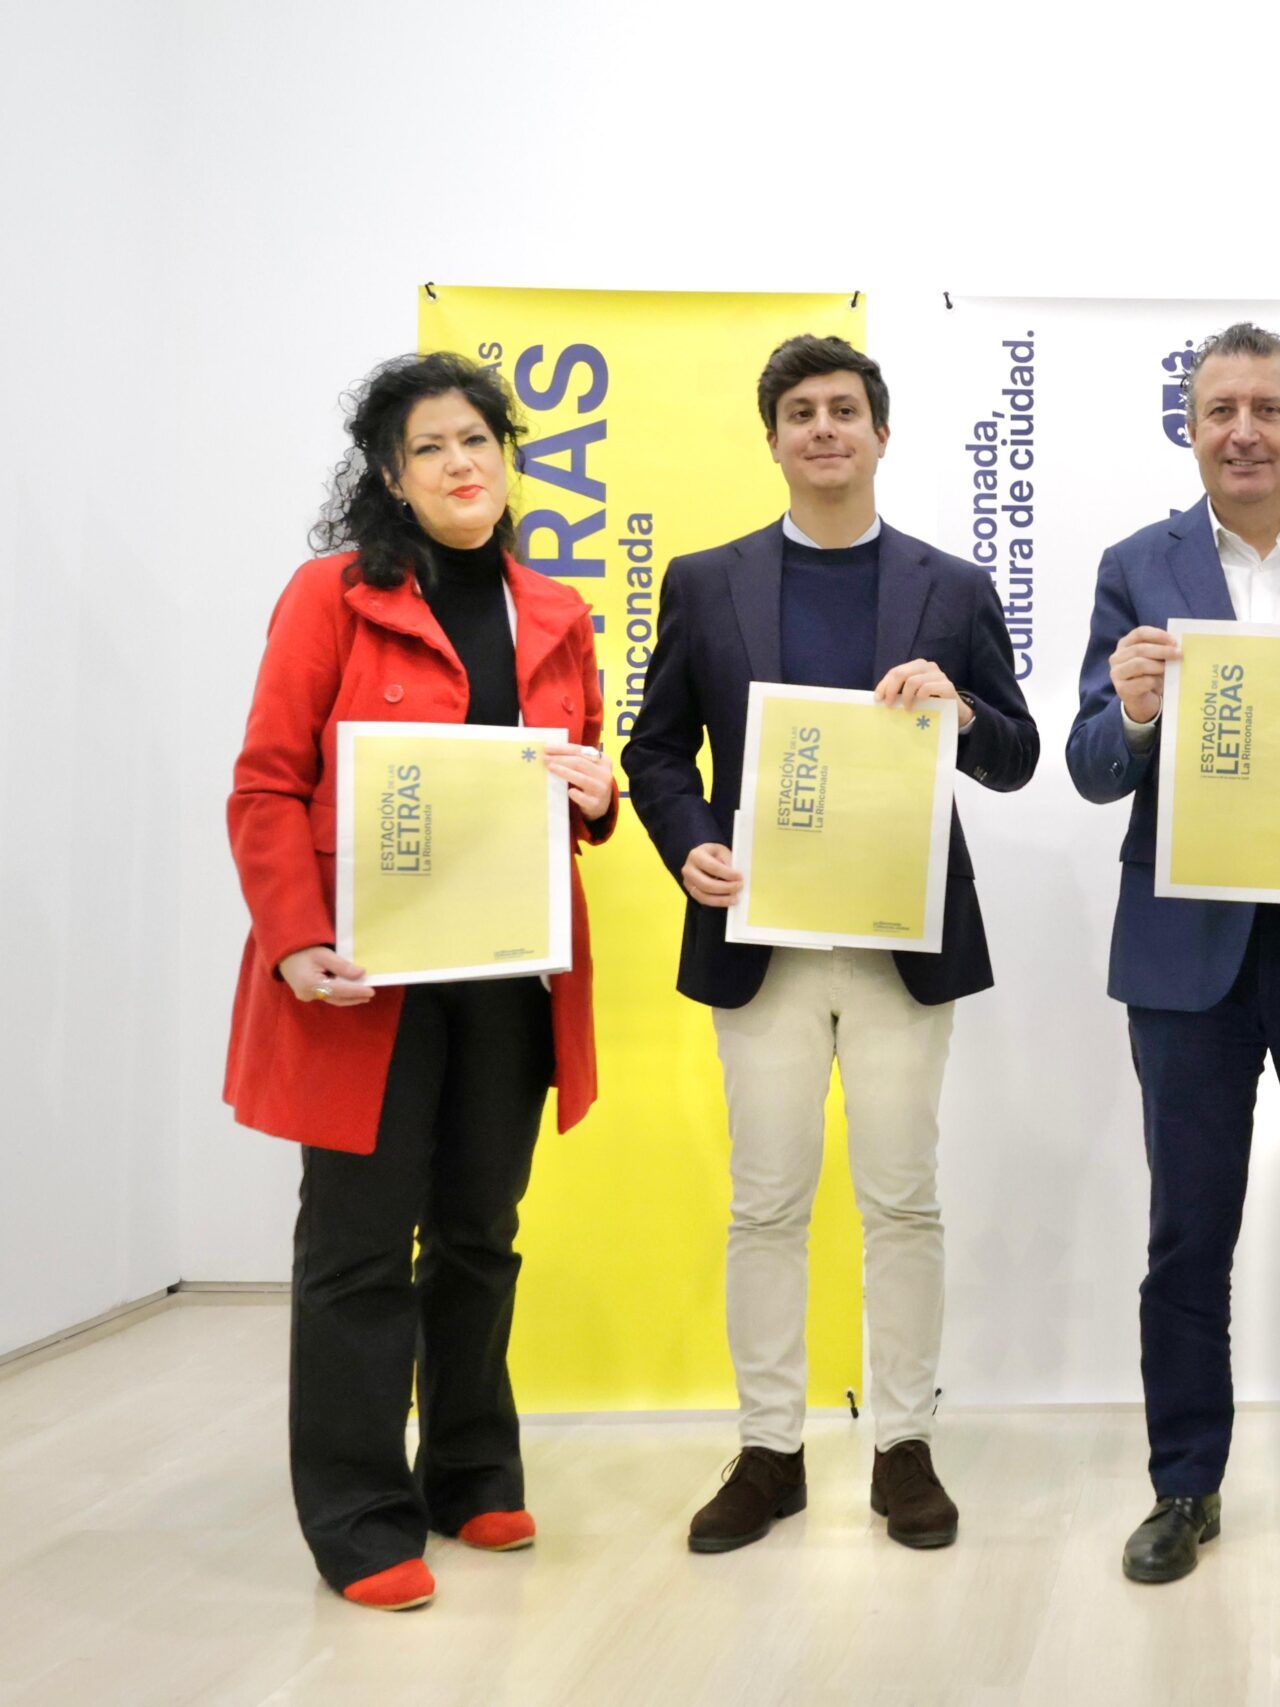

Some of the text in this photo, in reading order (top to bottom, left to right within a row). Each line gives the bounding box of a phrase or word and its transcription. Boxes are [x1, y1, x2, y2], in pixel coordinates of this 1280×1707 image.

[1001, 330, 1035, 461] ciudad.
[965, 410, 1006, 588] conada,
[1001, 480, 1034, 529] de
[1200, 692, 1217, 774] ESTACIÓN
[1216, 664, 1244, 775] LETRAS
[1241, 705, 1253, 775] La Rinconada
[396, 764, 421, 872] LETRAS
[777, 752, 796, 827] ESTACIÓN
[791, 727, 821, 829] LETRAS
[815, 765, 829, 829] La Rinconada
[378, 792, 395, 871] ESTACIÓN
[423, 804, 432, 872] La Rinconada
